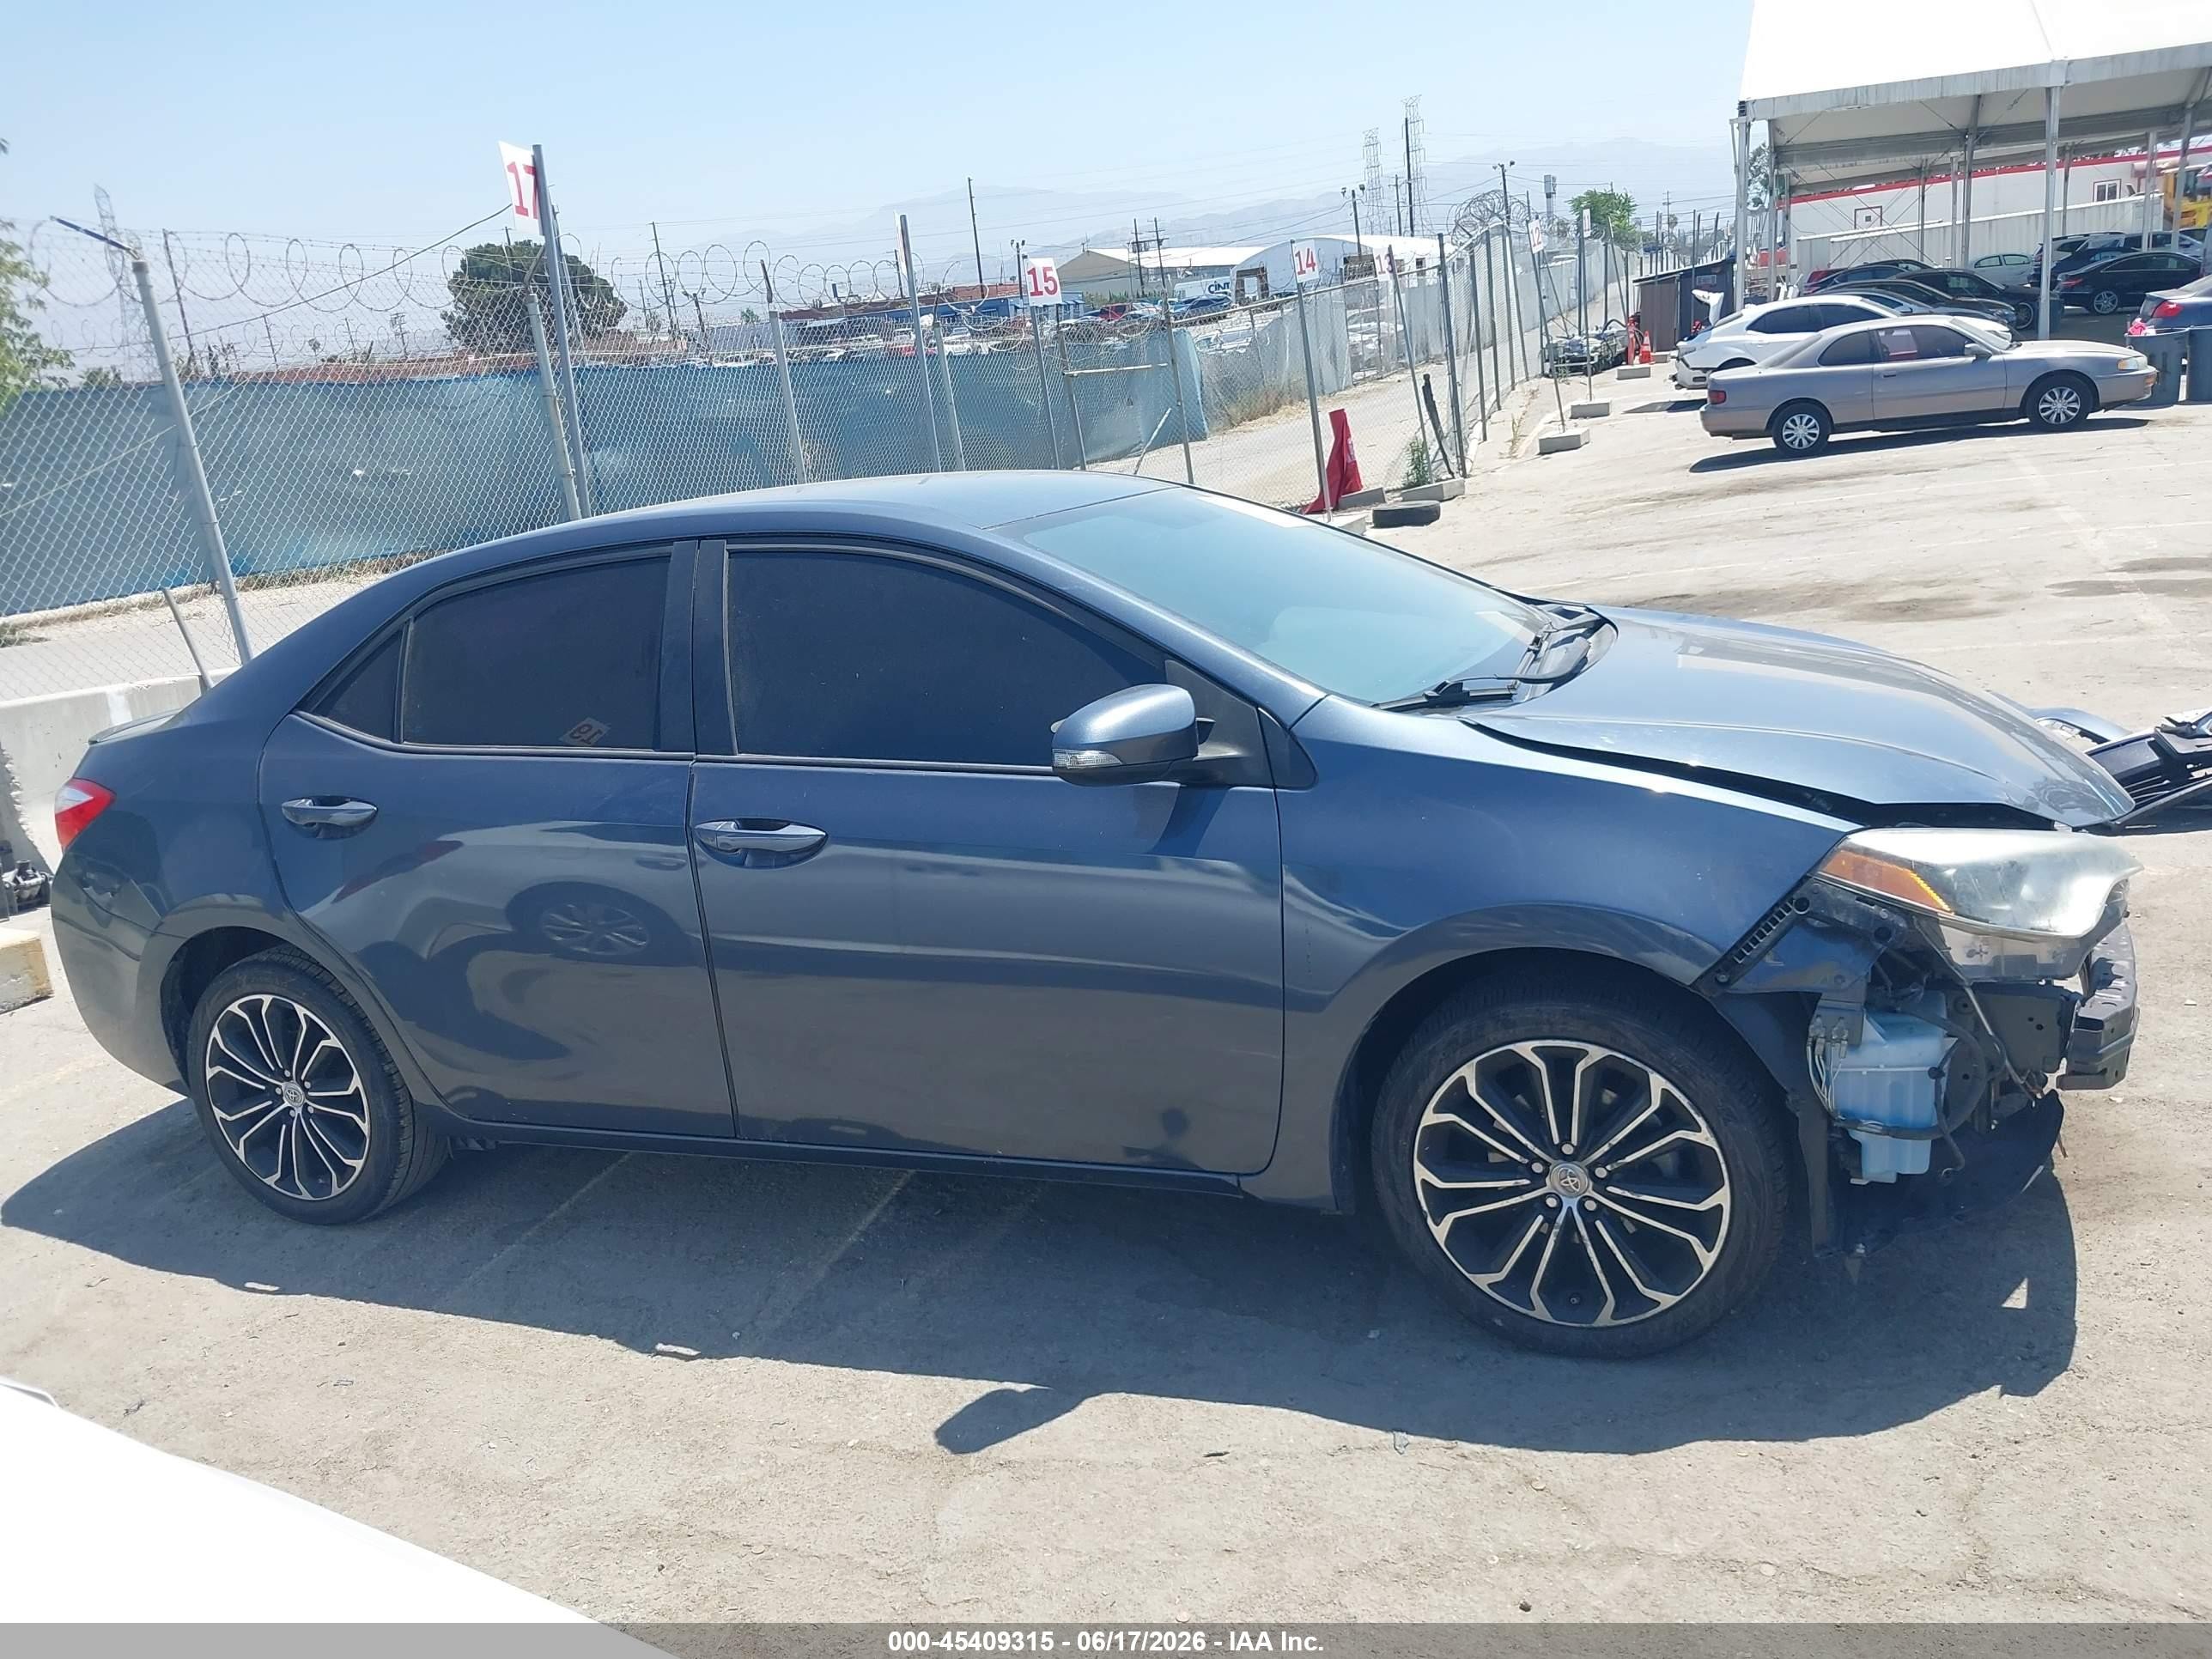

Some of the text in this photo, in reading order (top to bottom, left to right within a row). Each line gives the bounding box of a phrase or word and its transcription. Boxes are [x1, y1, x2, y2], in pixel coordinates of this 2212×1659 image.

[507, 161, 538, 220] 17
[1530, 226, 1542, 248] 12
[1295, 247, 1316, 276] 14
[1375, 253, 1395, 275] 13
[1027, 266, 1058, 297] 15
